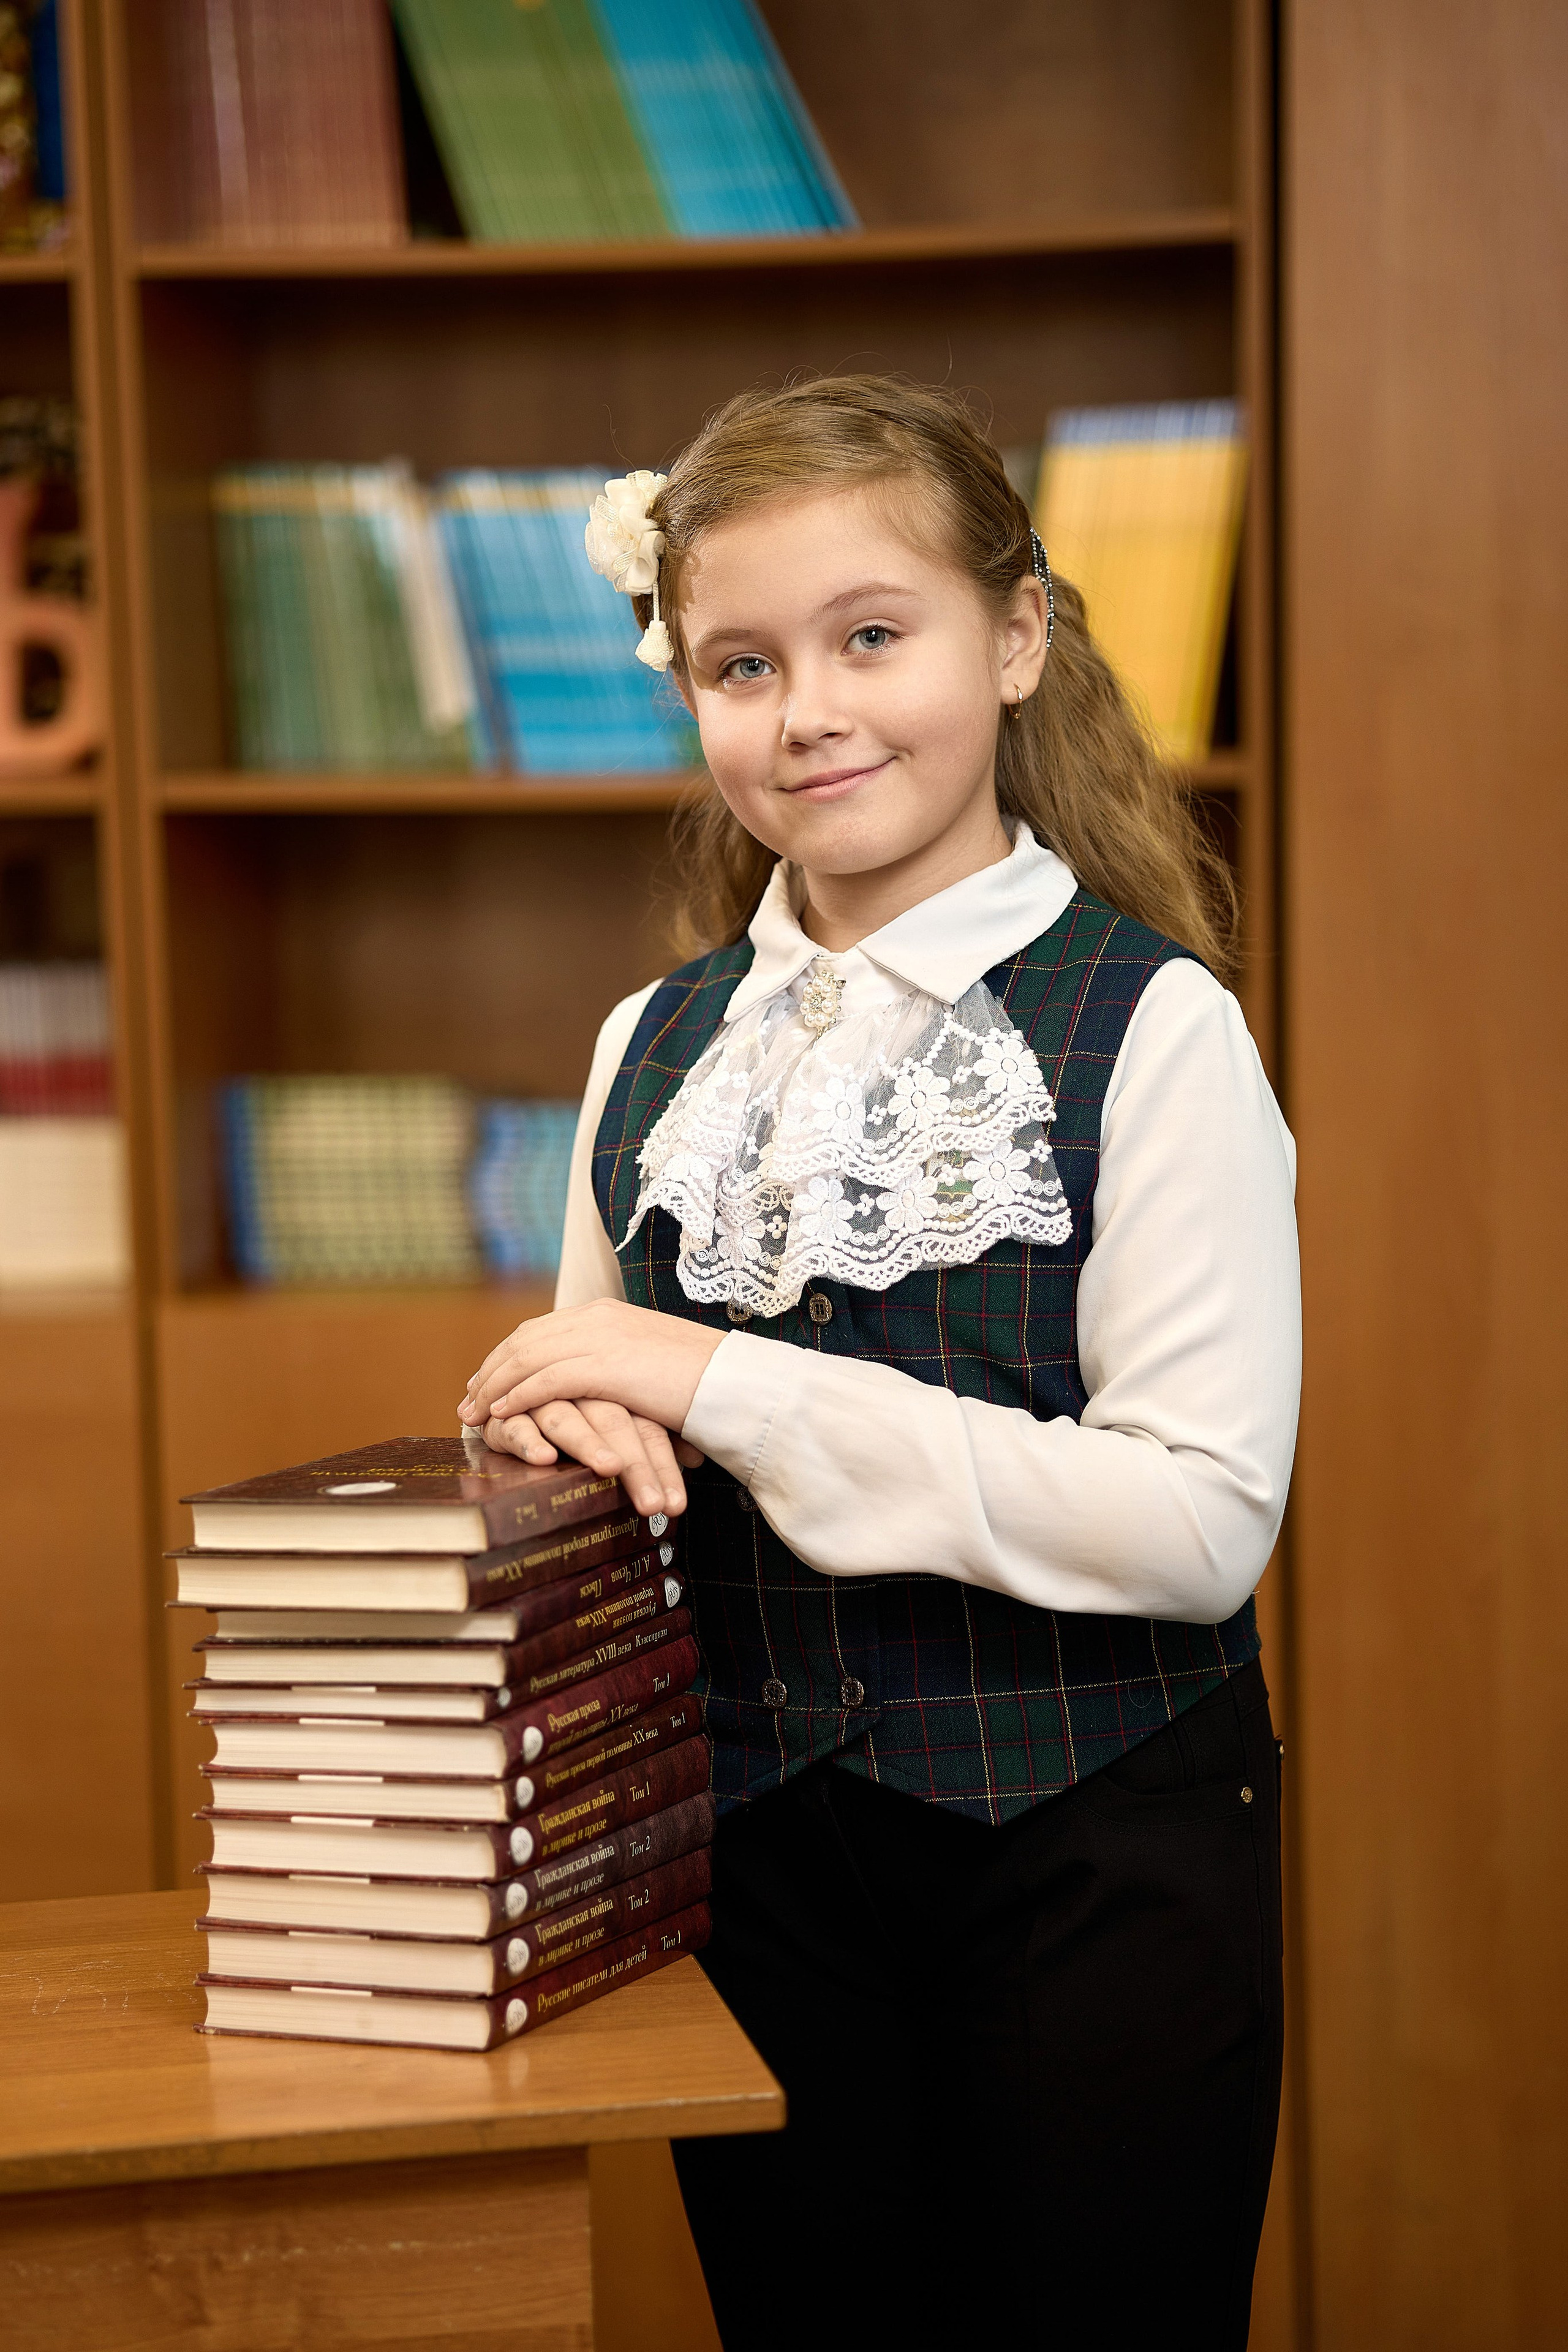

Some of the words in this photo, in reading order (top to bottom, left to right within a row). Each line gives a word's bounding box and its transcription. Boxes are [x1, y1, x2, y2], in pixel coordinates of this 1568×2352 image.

[591, 1516, 639, 1545] Драматургия
[562, 1536, 589, 1560] второй
[611, 1566, 631, 1583] Чехов
[631, 1559, 641, 1578] П.
[641, 1554, 650, 1573] А.
[579, 1578, 602, 1598] Пьесы
[633, 1587, 654, 1607] первой
[606, 1599, 633, 1615] половины
[613, 1610, 633, 1629] поэзия
[633, 1600, 656, 1622] Русская
[575, 1615, 591, 1628] века
[530, 1673, 557, 1693] Русская
[559, 1657, 595, 1681] литература
[595, 1643, 616, 1664] XVIII
[617, 1642, 631, 1656] века
[635, 1628, 668, 1647] Классицизм
[547, 1708, 580, 1732] Русская
[580, 1699, 601, 1719] проза
[653, 1677, 665, 1692] Том
[622, 1702, 639, 1717] века
[546, 1768, 570, 1788] Русская
[569, 1762, 586, 1777] проза
[586, 1748, 606, 1768] первой
[606, 1739, 633, 1759] половины
[646, 1727, 658, 1740] века
[670, 1716, 682, 1728] Том
[538, 1801, 591, 1834] Гражданская
[592, 1789, 616, 1808] война
[630, 1787, 644, 1802] Том
[646, 1781, 650, 1796] 1
[542, 1845, 548, 1856] в
[548, 1833, 576, 1854] лирике
[578, 1831, 583, 1842] и
[584, 1819, 607, 1839] прозе
[533, 1856, 590, 1890] Гражданская
[590, 1844, 615, 1864] война
[630, 1841, 644, 1856] Том
[645, 1836, 650, 1850] 2
[535, 1899, 541, 1911] в
[542, 1885, 572, 1907] лирике
[574, 1883, 579, 1894] и
[580, 1872, 605, 1893] прозе
[535, 1911, 590, 1946] Гражданская
[590, 1898, 613, 1918] война
[628, 1895, 643, 1911] Том
[644, 1888, 649, 1904] 2
[538, 1955, 544, 1967] в
[545, 1941, 573, 1964] лирике
[575, 1937, 580, 1948] и
[581, 1927, 605, 1947] прозе
[537, 1986, 571, 2013] Русские
[573, 1968, 608, 1996] писатели
[609, 1960, 624, 1978] для
[625, 1945, 647, 1970] детей
[661, 1936, 676, 1951] Том
[677, 1929, 682, 1945] 1
